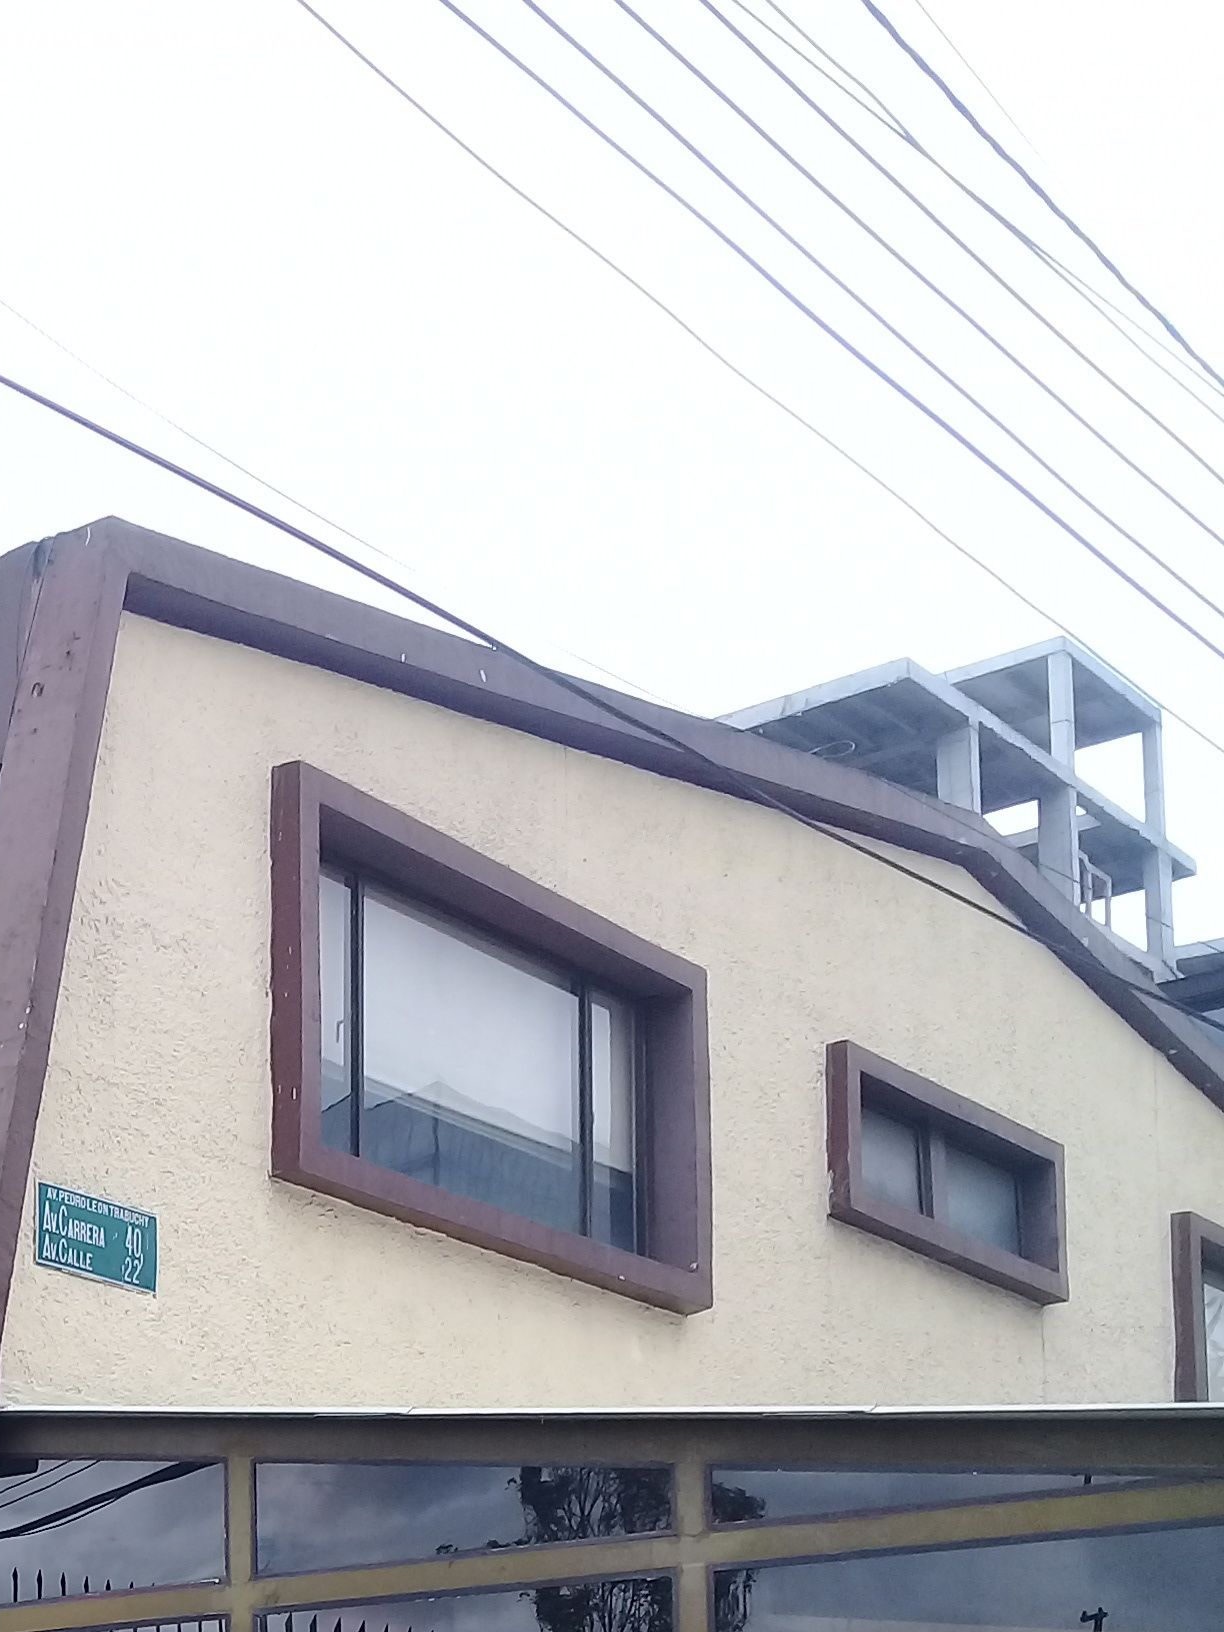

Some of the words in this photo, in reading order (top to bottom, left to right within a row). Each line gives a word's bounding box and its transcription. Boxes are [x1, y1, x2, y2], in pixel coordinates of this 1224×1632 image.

[109, 1205, 150, 1228] TRABUCHY
[125, 1224, 142, 1258] 40
[123, 1257, 143, 1284] 22
